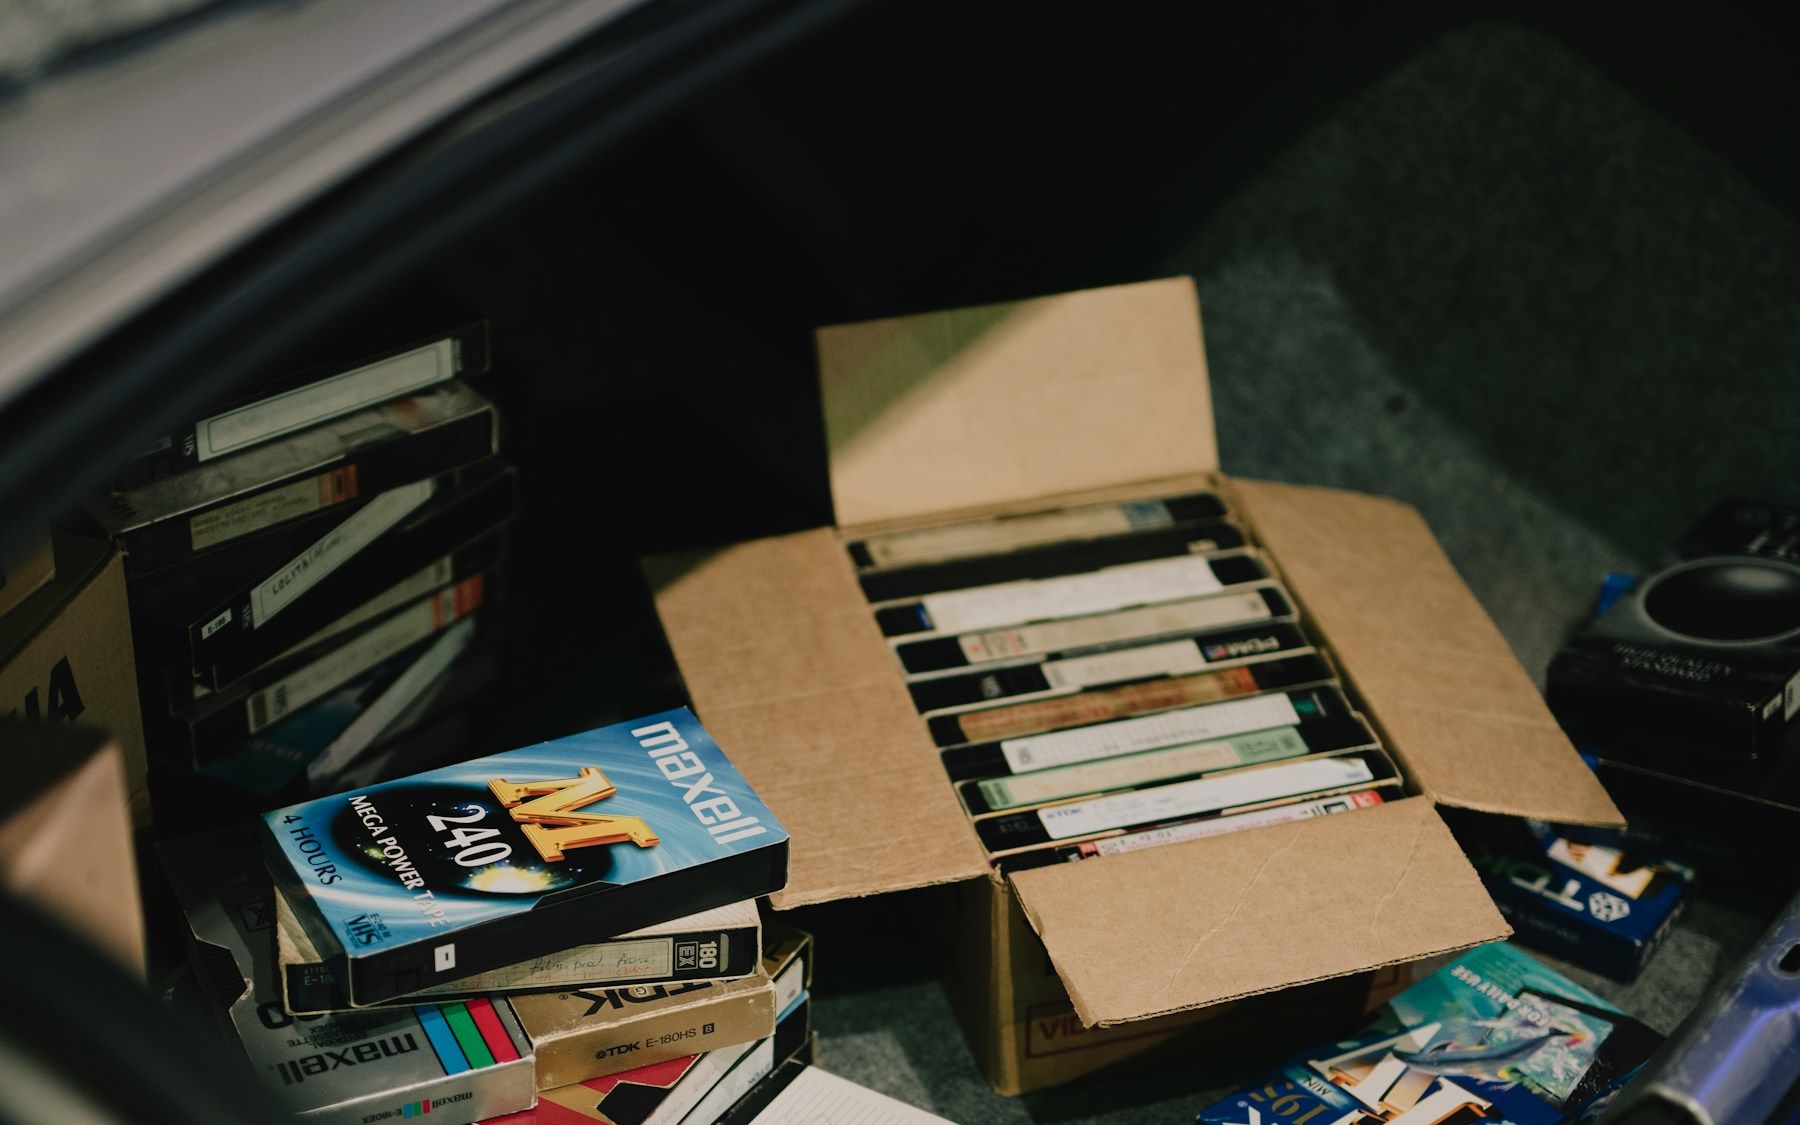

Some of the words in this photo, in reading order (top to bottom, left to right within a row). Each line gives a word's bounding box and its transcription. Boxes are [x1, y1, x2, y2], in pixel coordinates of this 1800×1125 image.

[631, 721, 767, 845] maxell
[282, 813, 303, 825] 4
[487, 765, 661, 863] M
[426, 804, 514, 867] 240
[289, 826, 343, 887] HOURS
[348, 794, 389, 838] MEGA
[376, 835, 426, 891] POWER
[413, 889, 450, 928] TAPE
[347, 914, 382, 947] VHS
[679, 945, 696, 968] EX
[700, 940, 718, 969] 180
[605, 1041, 641, 1057] TDK
[645, 1028, 697, 1048] E-180HS
[276, 1032, 420, 1086] maxell
[432, 1091, 474, 1110] maxell
[1302, 1074, 1331, 1097] MIN
[361, 1107, 403, 1125] E-180EX
